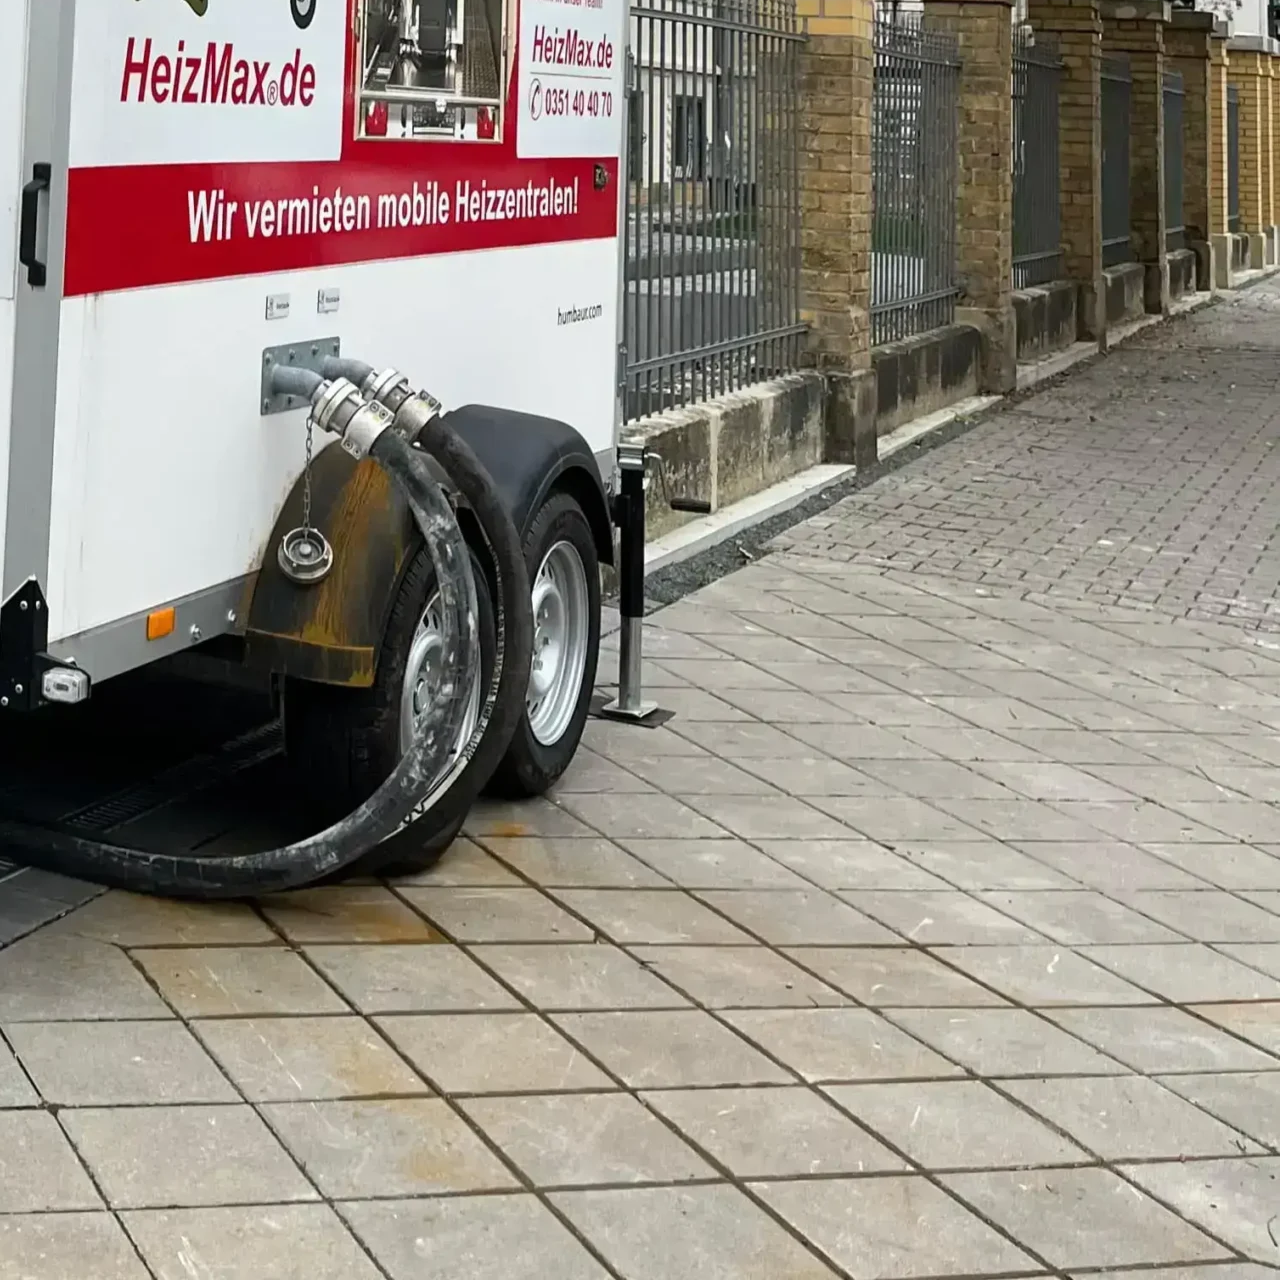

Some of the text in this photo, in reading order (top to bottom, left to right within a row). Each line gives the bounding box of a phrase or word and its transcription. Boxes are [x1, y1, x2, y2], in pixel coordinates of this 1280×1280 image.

[532, 25, 613, 69] HeizMax.de
[545, 88, 612, 117] 0351 40 40 70
[187, 176, 579, 243] Wir vermieten mobile Heizzentralen!
[557, 303, 602, 326] humbaur.com
